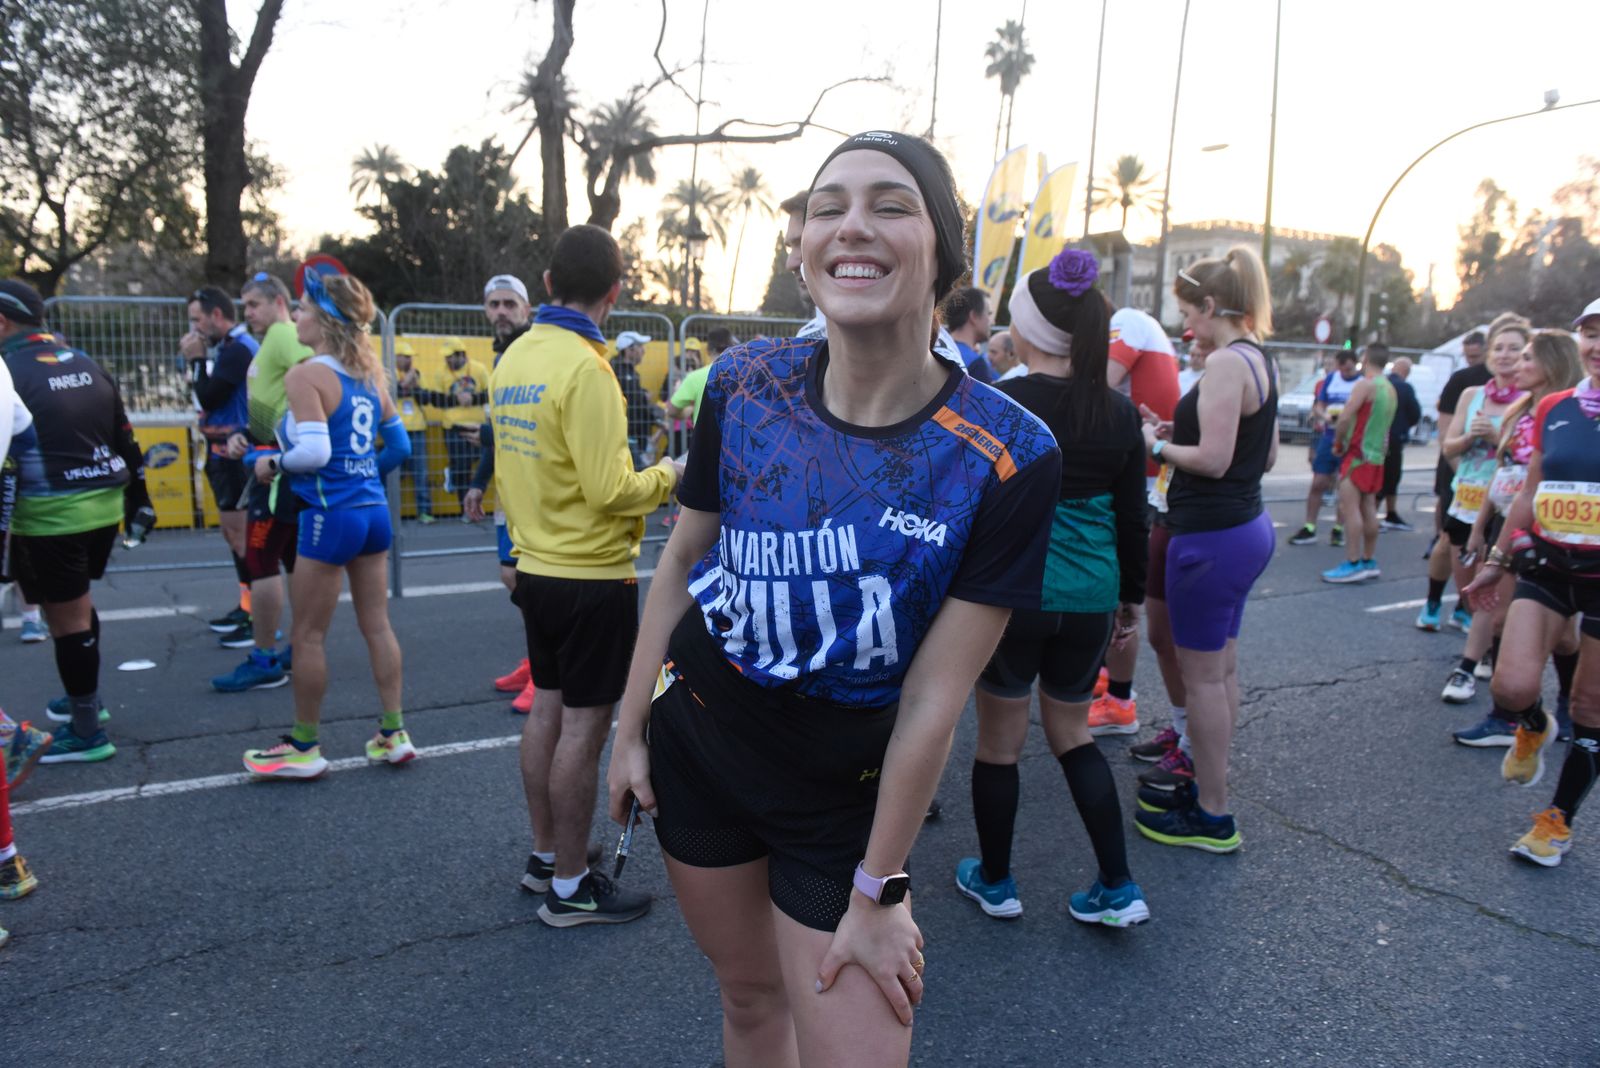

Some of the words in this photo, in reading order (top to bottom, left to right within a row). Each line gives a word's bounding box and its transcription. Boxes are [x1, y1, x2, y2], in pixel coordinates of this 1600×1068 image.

[48, 372, 93, 391] PAREJO
[878, 507, 947, 547] HOKA
[730, 518, 860, 577] MARATÓN
